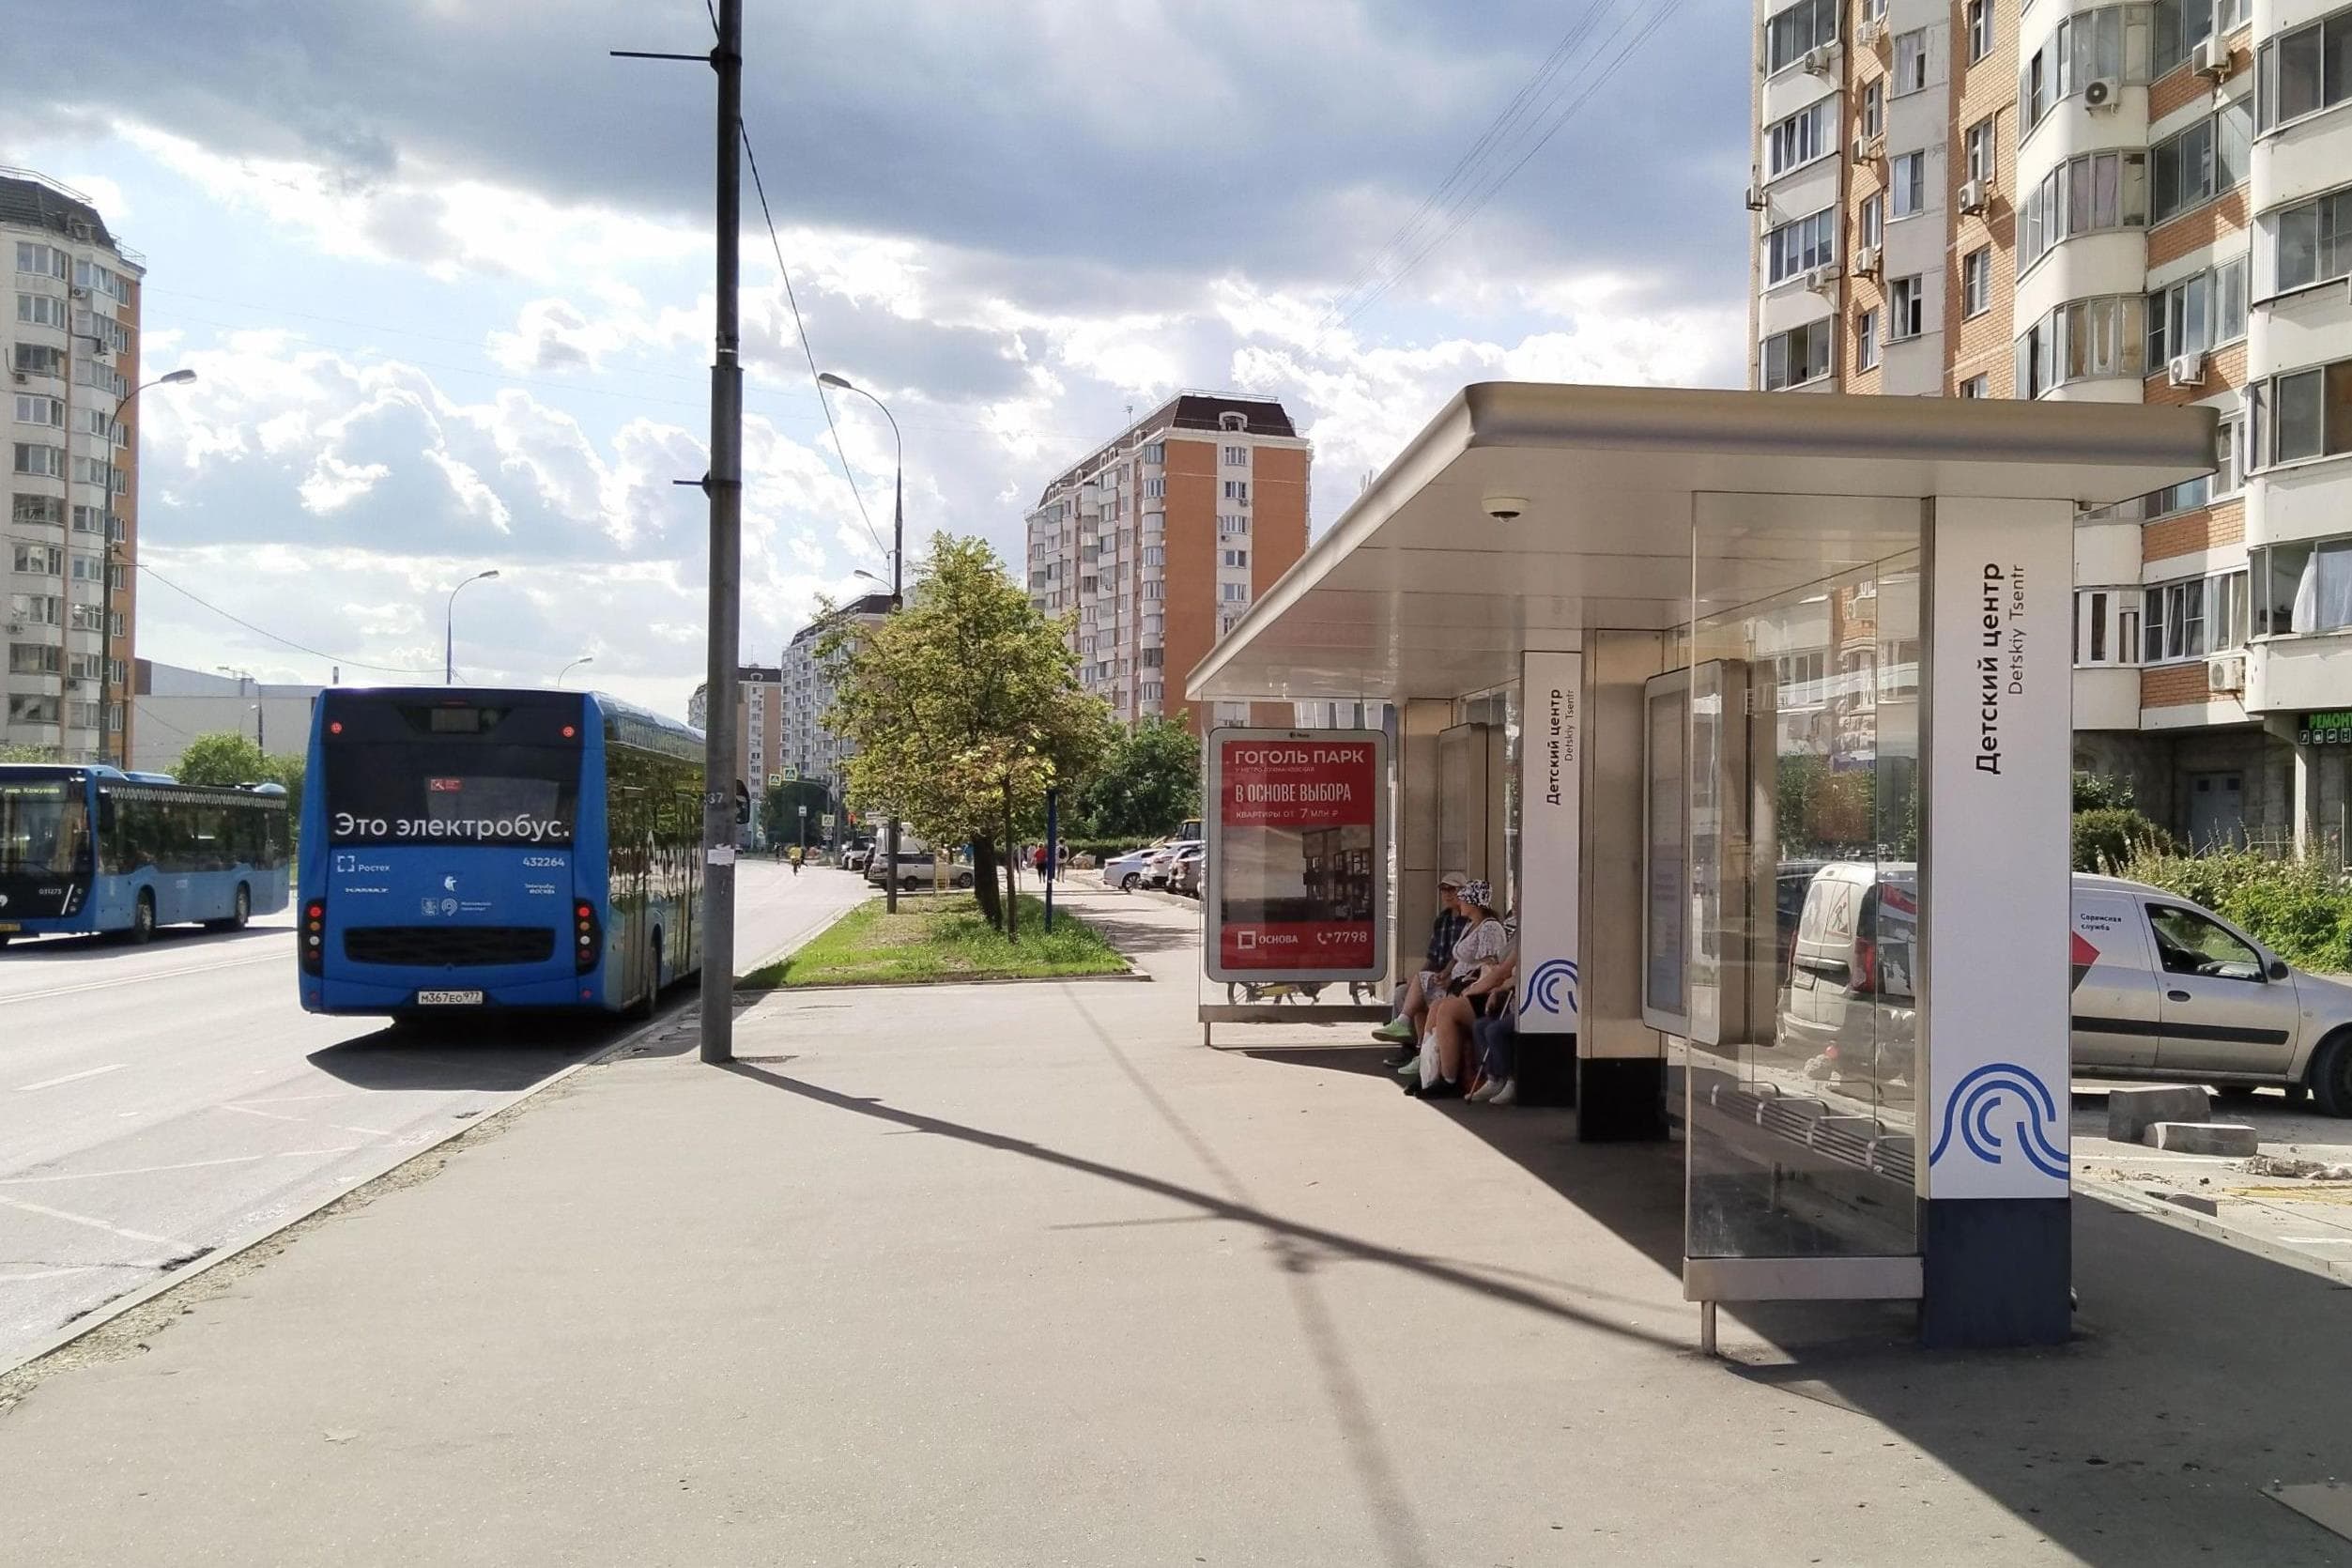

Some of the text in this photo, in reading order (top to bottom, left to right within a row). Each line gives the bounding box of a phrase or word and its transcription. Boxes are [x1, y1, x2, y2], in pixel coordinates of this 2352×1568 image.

[2007, 564, 2026, 695] Detskiy Tsentr
[1975, 563, 2005, 775] Детский центр
[1564, 690, 1575, 761] Detskiy Tsentr
[1235, 750, 1364, 764] ГОГОЛЬ ПАРК
[1546, 689, 1562, 806] Детский центр
[1236, 783, 1351, 803] В ОСНОВЕ ВЫБОРА
[1299, 808, 1308, 818] 7
[334, 812, 570, 842] Это электробус.
[358, 864, 391, 872] Ростех
[522, 856, 565, 868] 432264
[1258, 935, 1299, 945] ОСНОВА
